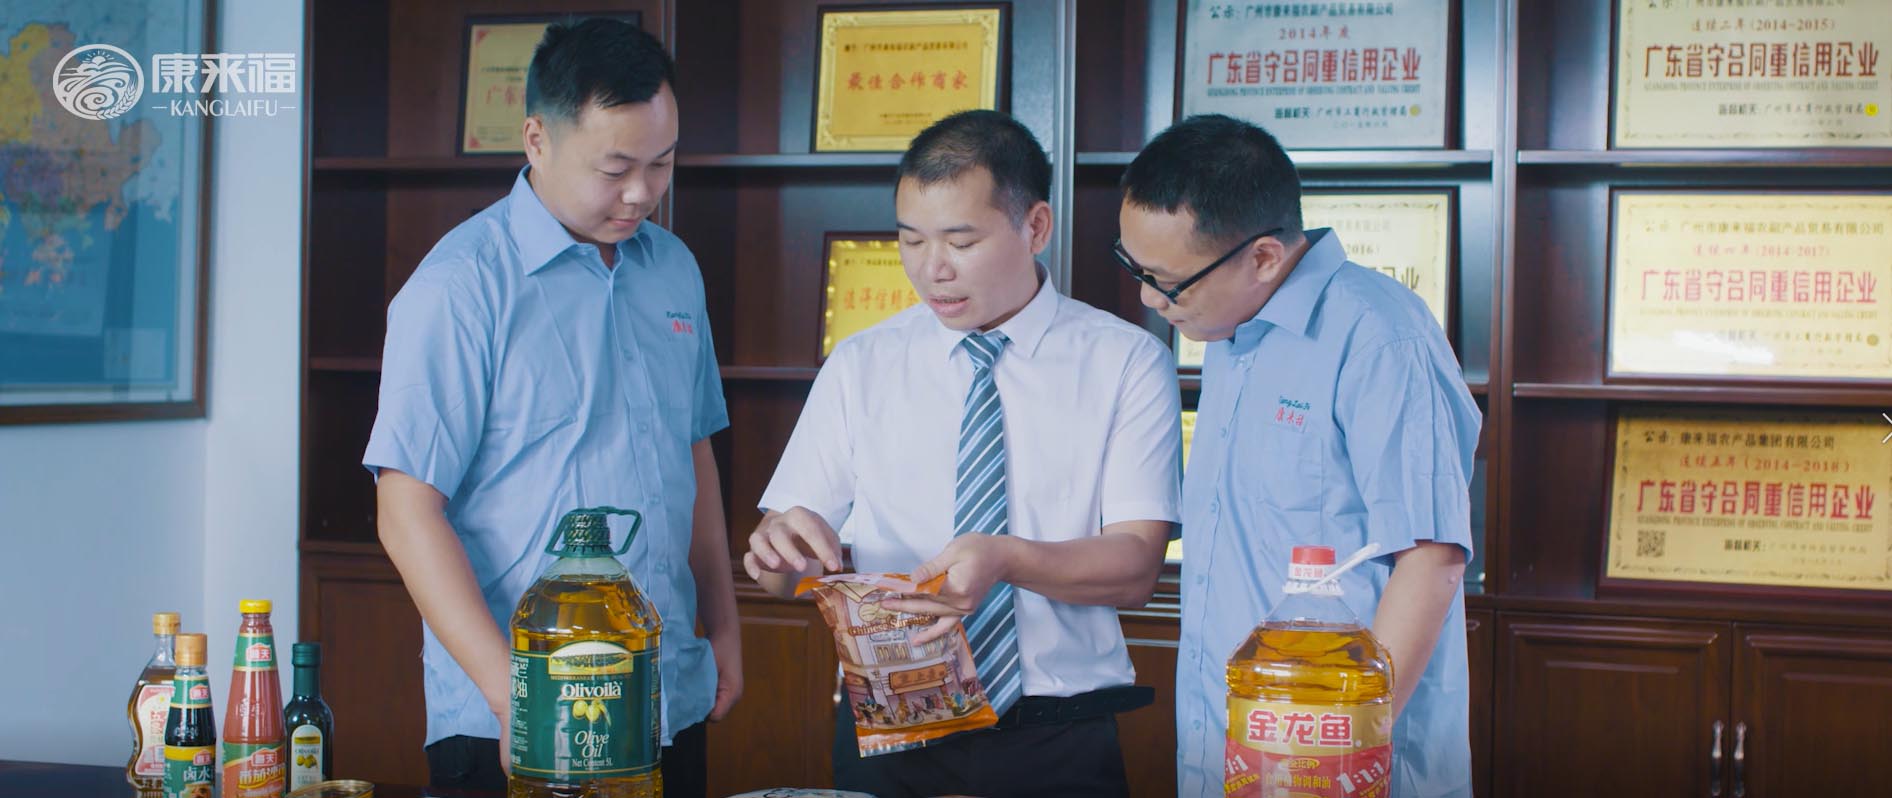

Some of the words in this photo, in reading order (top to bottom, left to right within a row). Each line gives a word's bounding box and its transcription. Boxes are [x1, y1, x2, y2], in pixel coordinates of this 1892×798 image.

[1207, 48, 1421, 85] 广东省守合同重信用企业
[1645, 42, 1879, 78] 广东省守合同重信用企业
[1641, 269, 1878, 304] 广东省守合同重信用企业
[1636, 479, 1876, 520] 广东省守合同重信用企业
[561, 682, 622, 698] Olivoilà
[574, 730, 609, 745] Olive
[1248, 710, 1352, 745] 金龙鱼
[582, 743, 603, 758] Oil
